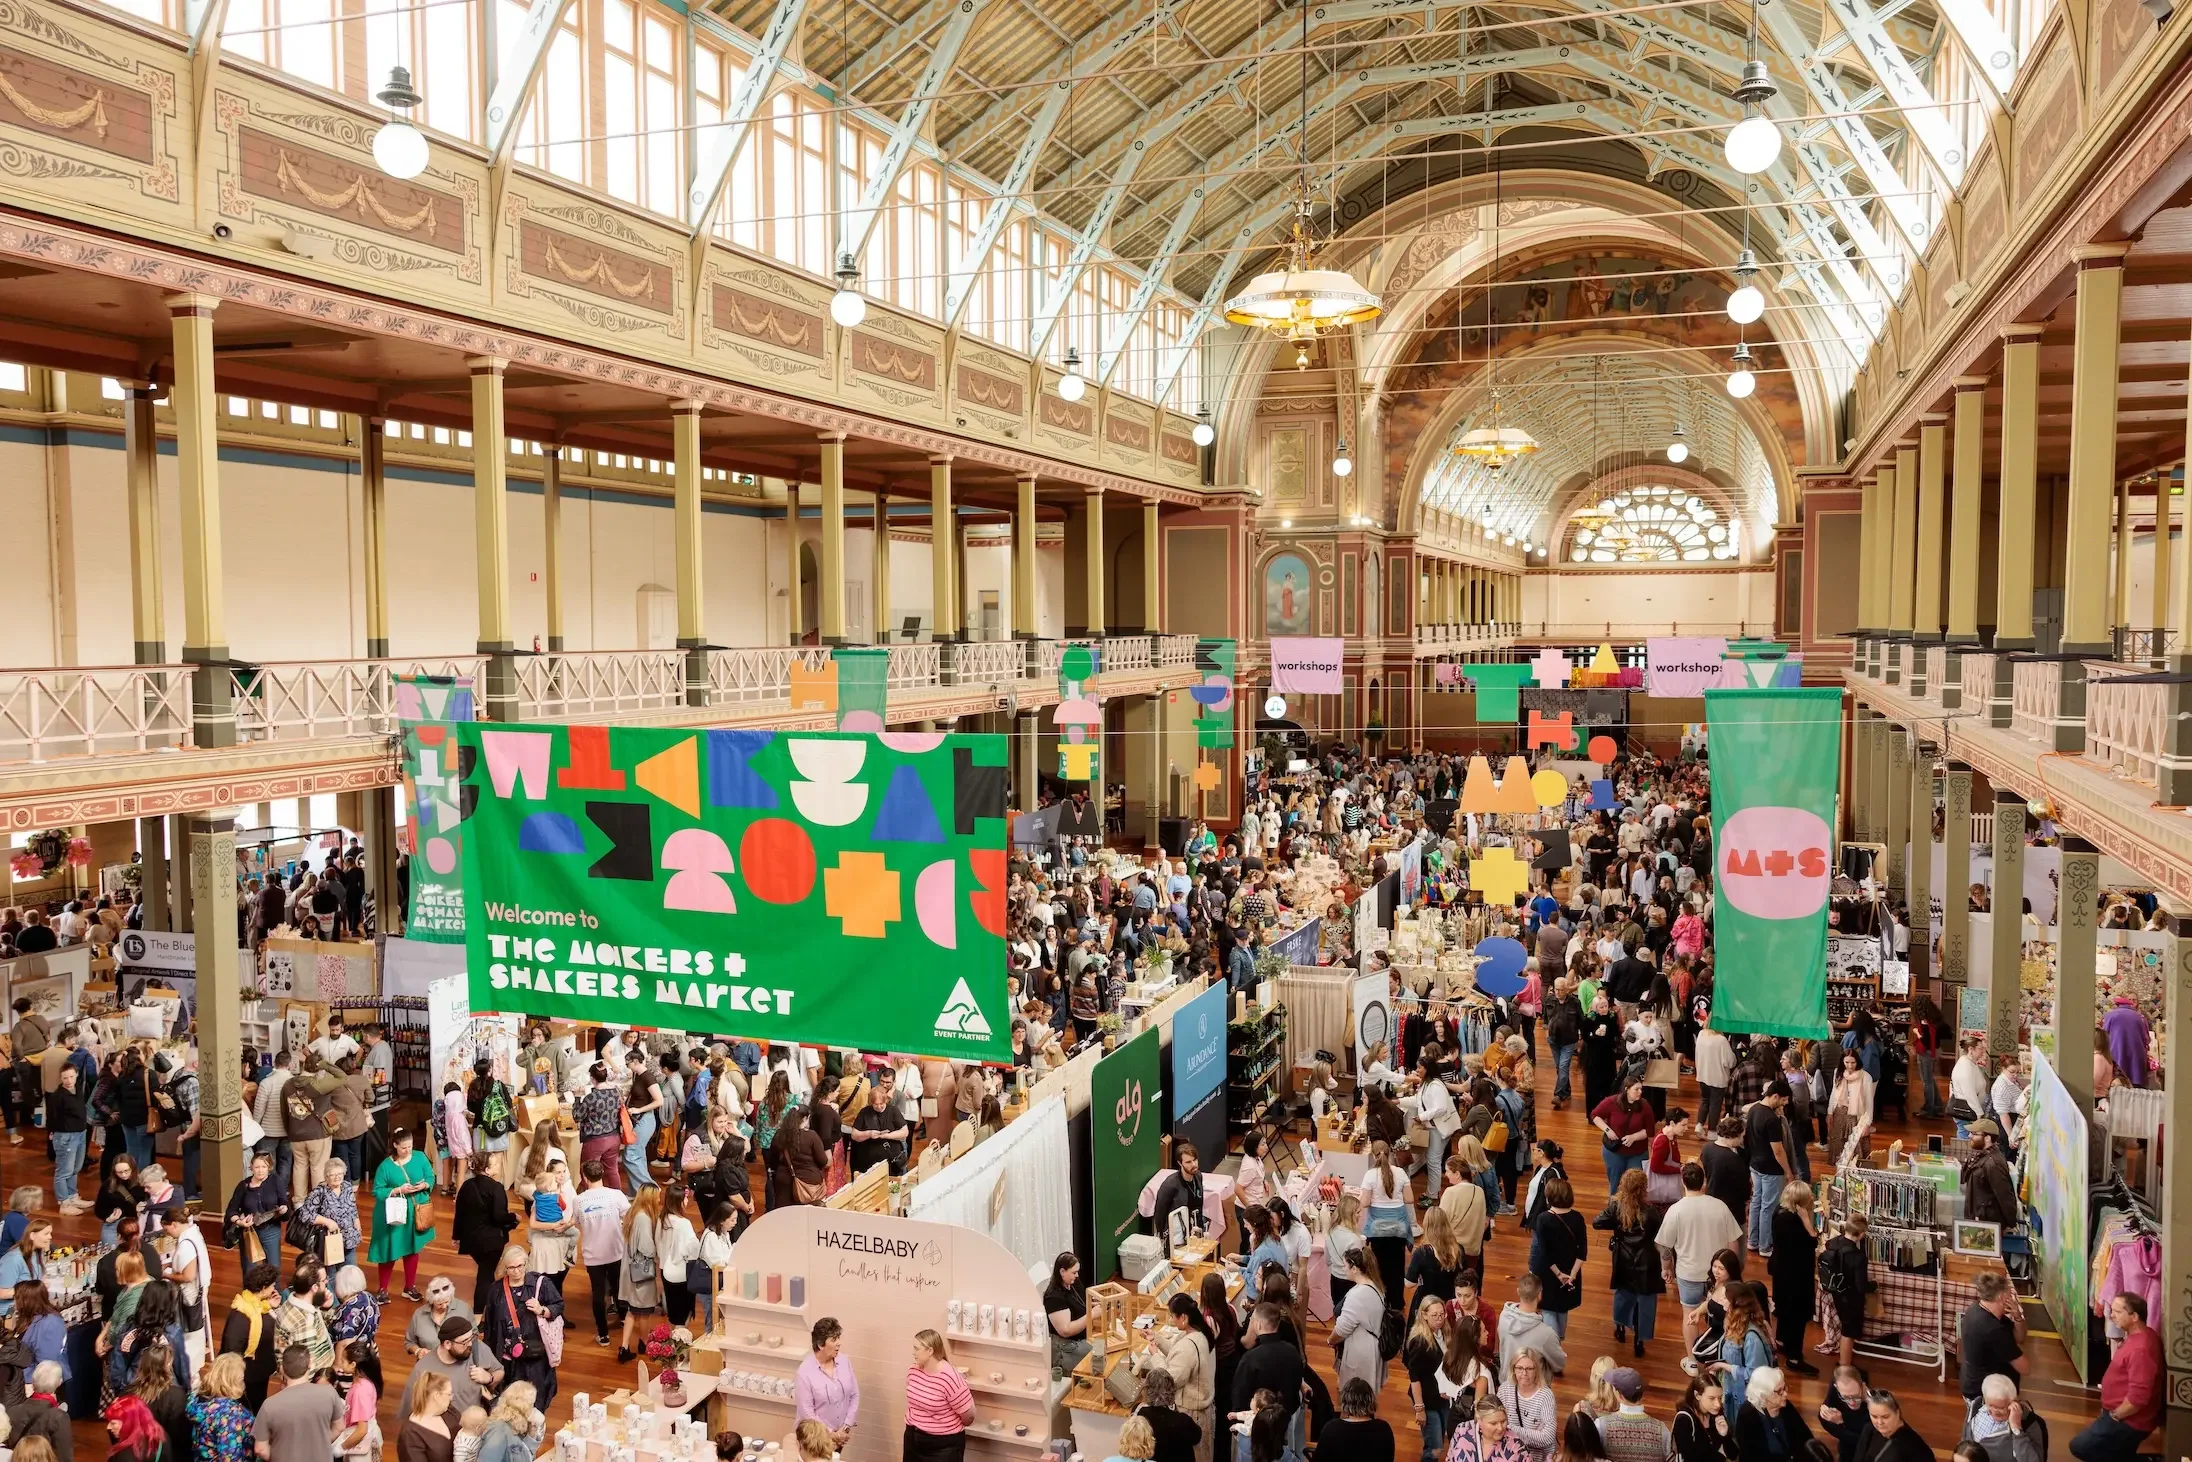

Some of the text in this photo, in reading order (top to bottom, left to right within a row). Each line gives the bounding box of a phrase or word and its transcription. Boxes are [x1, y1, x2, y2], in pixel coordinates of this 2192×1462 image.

[1278, 661, 1338, 673] workshops
[484, 901, 599, 929] Welcome to
[150, 939, 195, 952] The Blue
[934, 1030, 991, 1042] EVENT PARTNER
[817, 1229, 919, 1259] HAZELBABY
[838, 1257, 940, 1292] Candles that inspire
